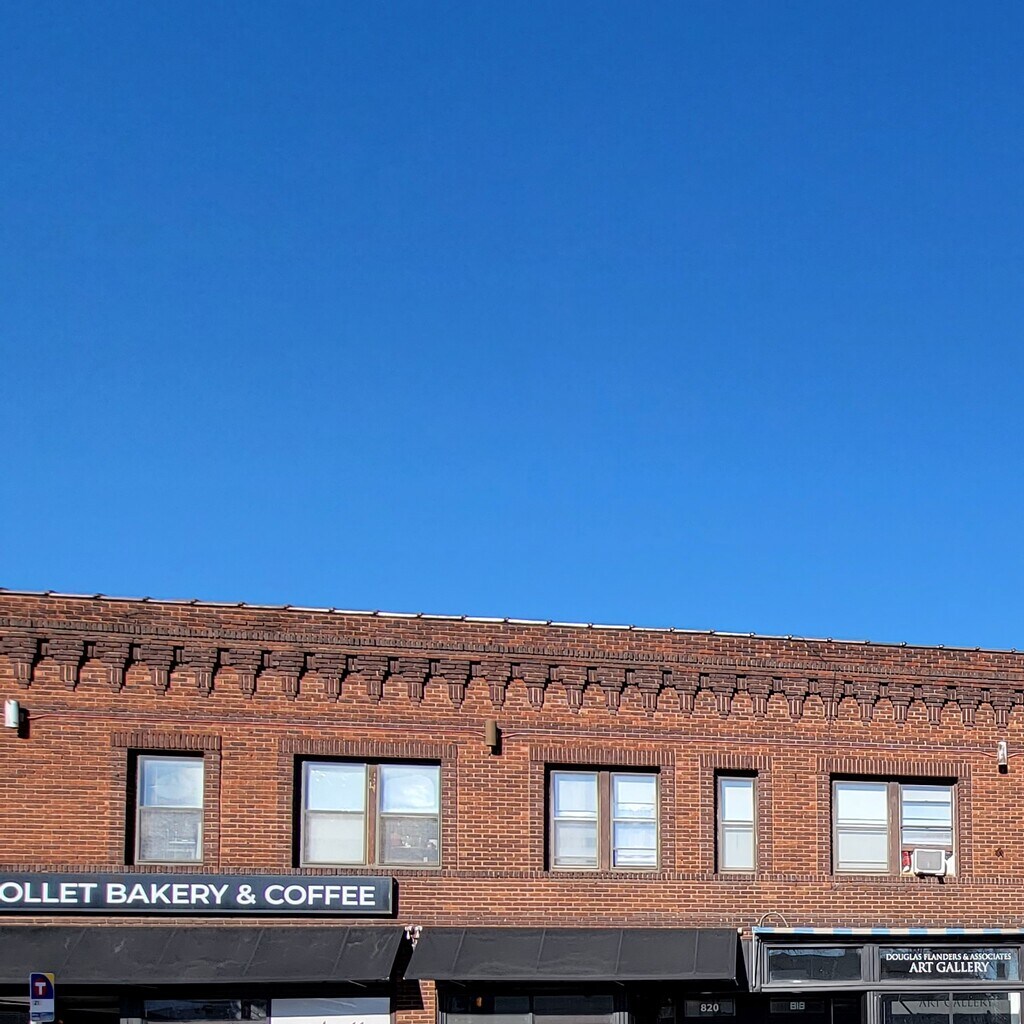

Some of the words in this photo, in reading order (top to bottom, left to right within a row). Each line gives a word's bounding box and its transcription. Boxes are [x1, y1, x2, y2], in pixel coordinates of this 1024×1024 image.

[0, 881, 98, 903] OLLET
[106, 883, 229, 904] BAKERY
[236, 884, 256, 905] &
[264, 885, 376, 906] COFFEE
[886, 953, 922, 961] DOUGLAS
[924, 953, 961, 961] FLANDERS
[970, 952, 1012, 960] ASSOCIATES
[909, 962, 934, 973] ART
[936, 961, 990, 973] GALLERY
[700, 1003, 719, 1012] 820
